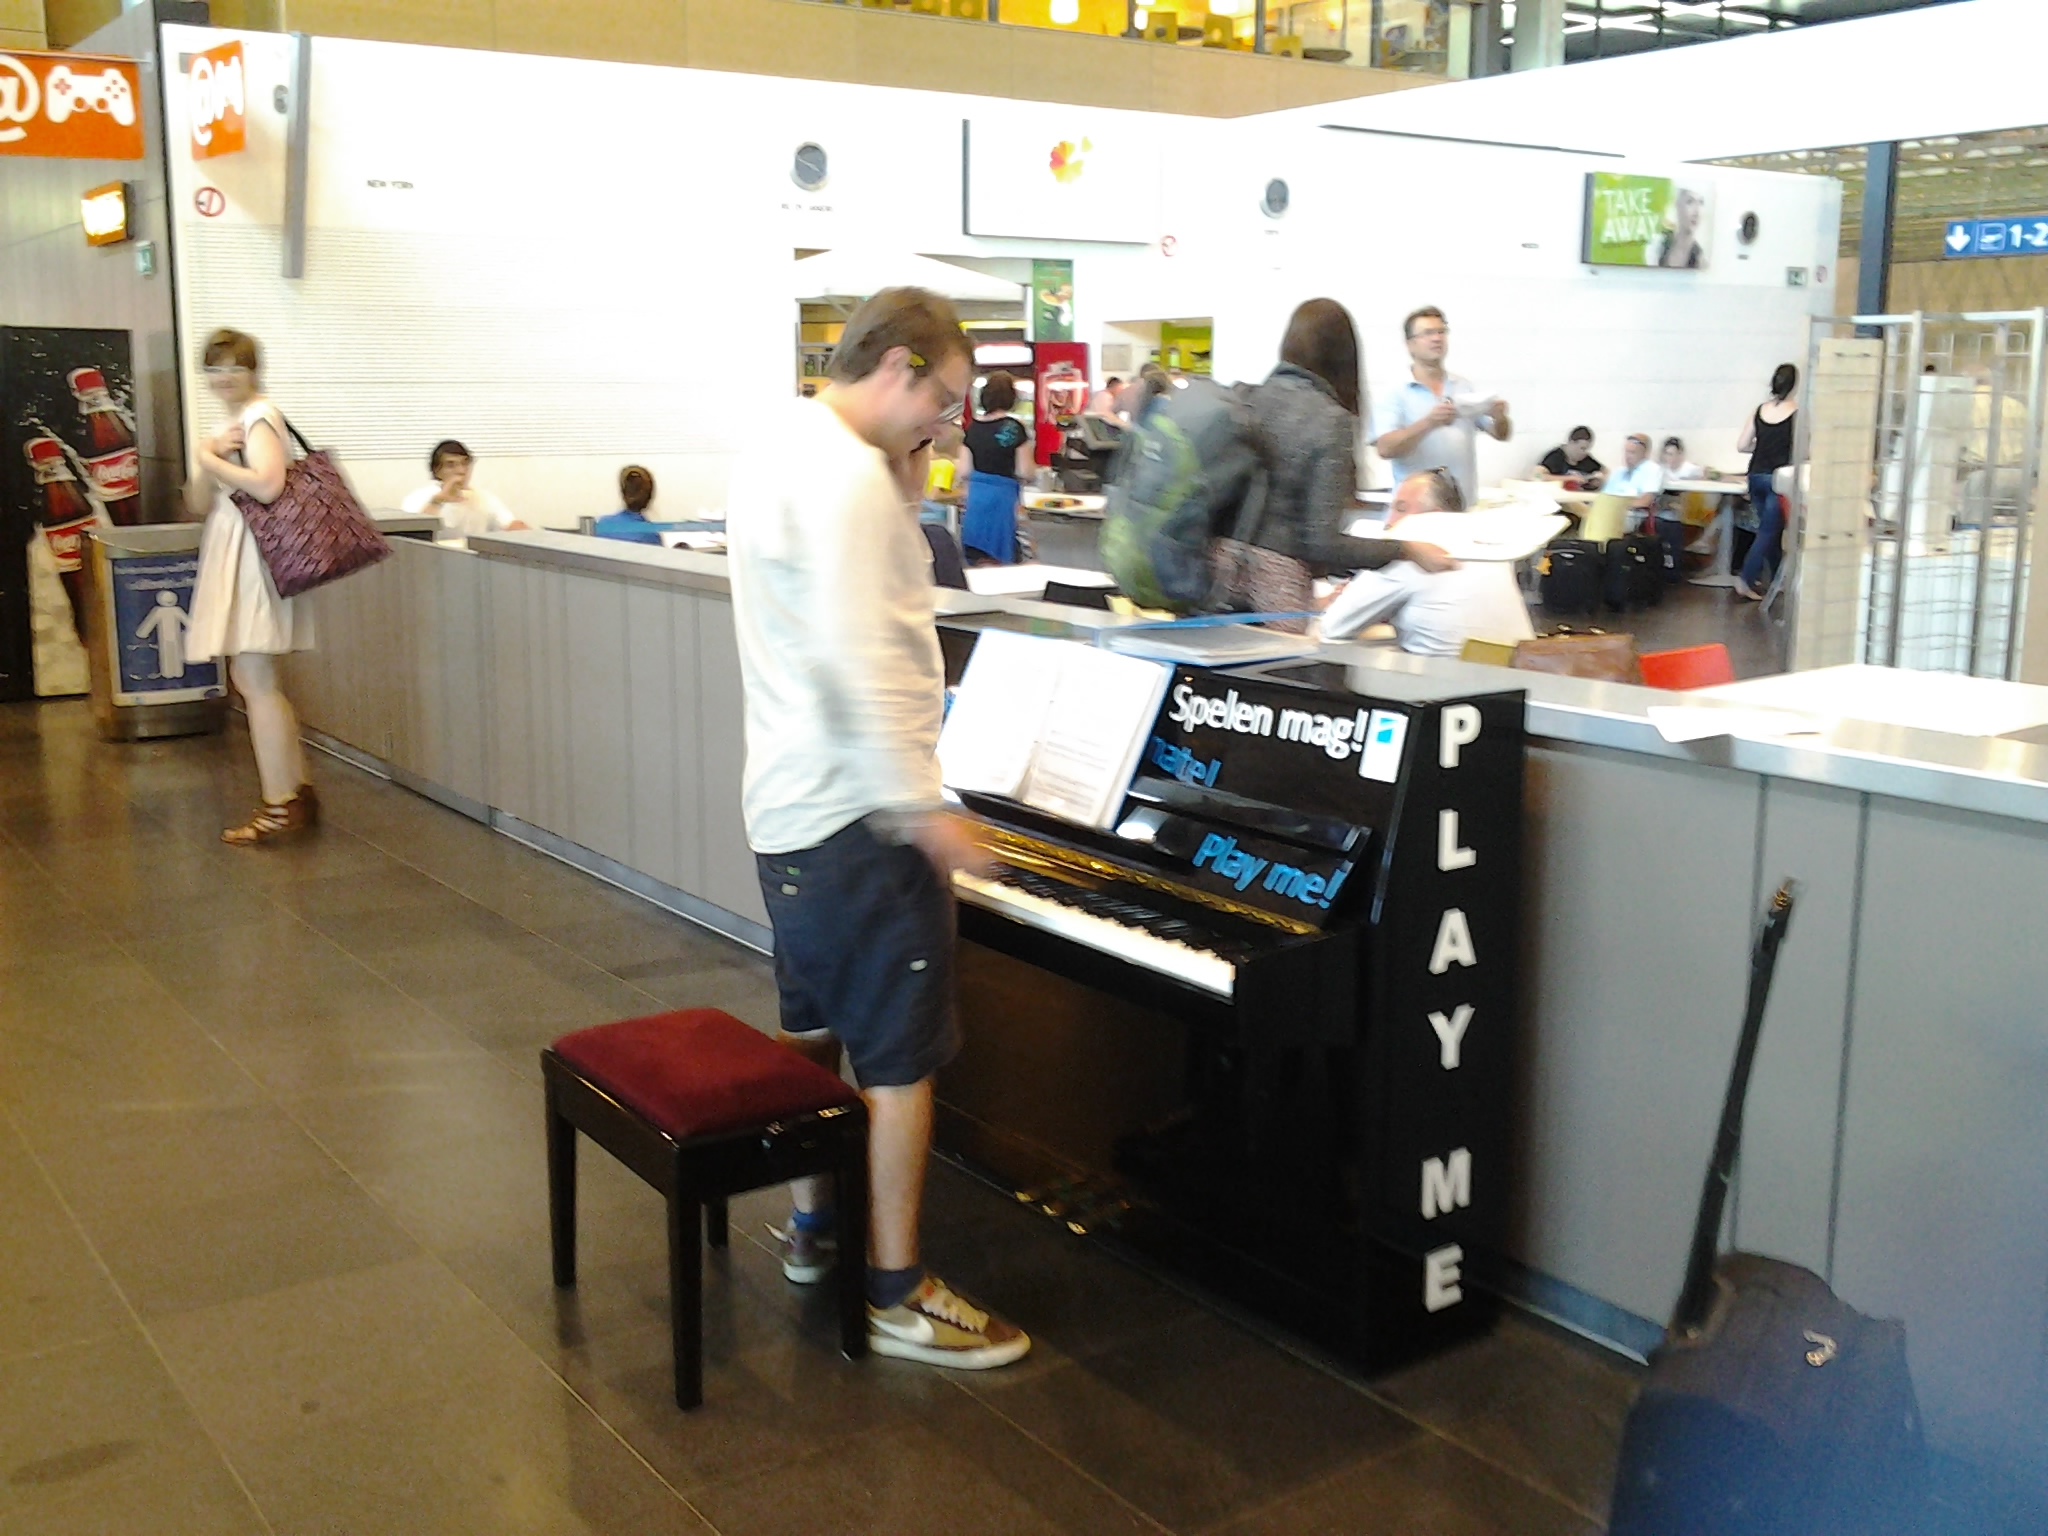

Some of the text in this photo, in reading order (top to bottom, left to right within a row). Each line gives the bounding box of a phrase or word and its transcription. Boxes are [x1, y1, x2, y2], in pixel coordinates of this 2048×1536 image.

[1600, 213, 1660, 245] AWAY
[1602, 187, 1654, 216] TAKE
[2008, 222, 2048, 248] 1-2
[1169, 682, 1369, 760] Spelen mag!
[1191, 832, 1348, 910] Play me!
[1427, 703, 1483, 1071] PLAY
[1420, 1146, 1472, 1315] ME
